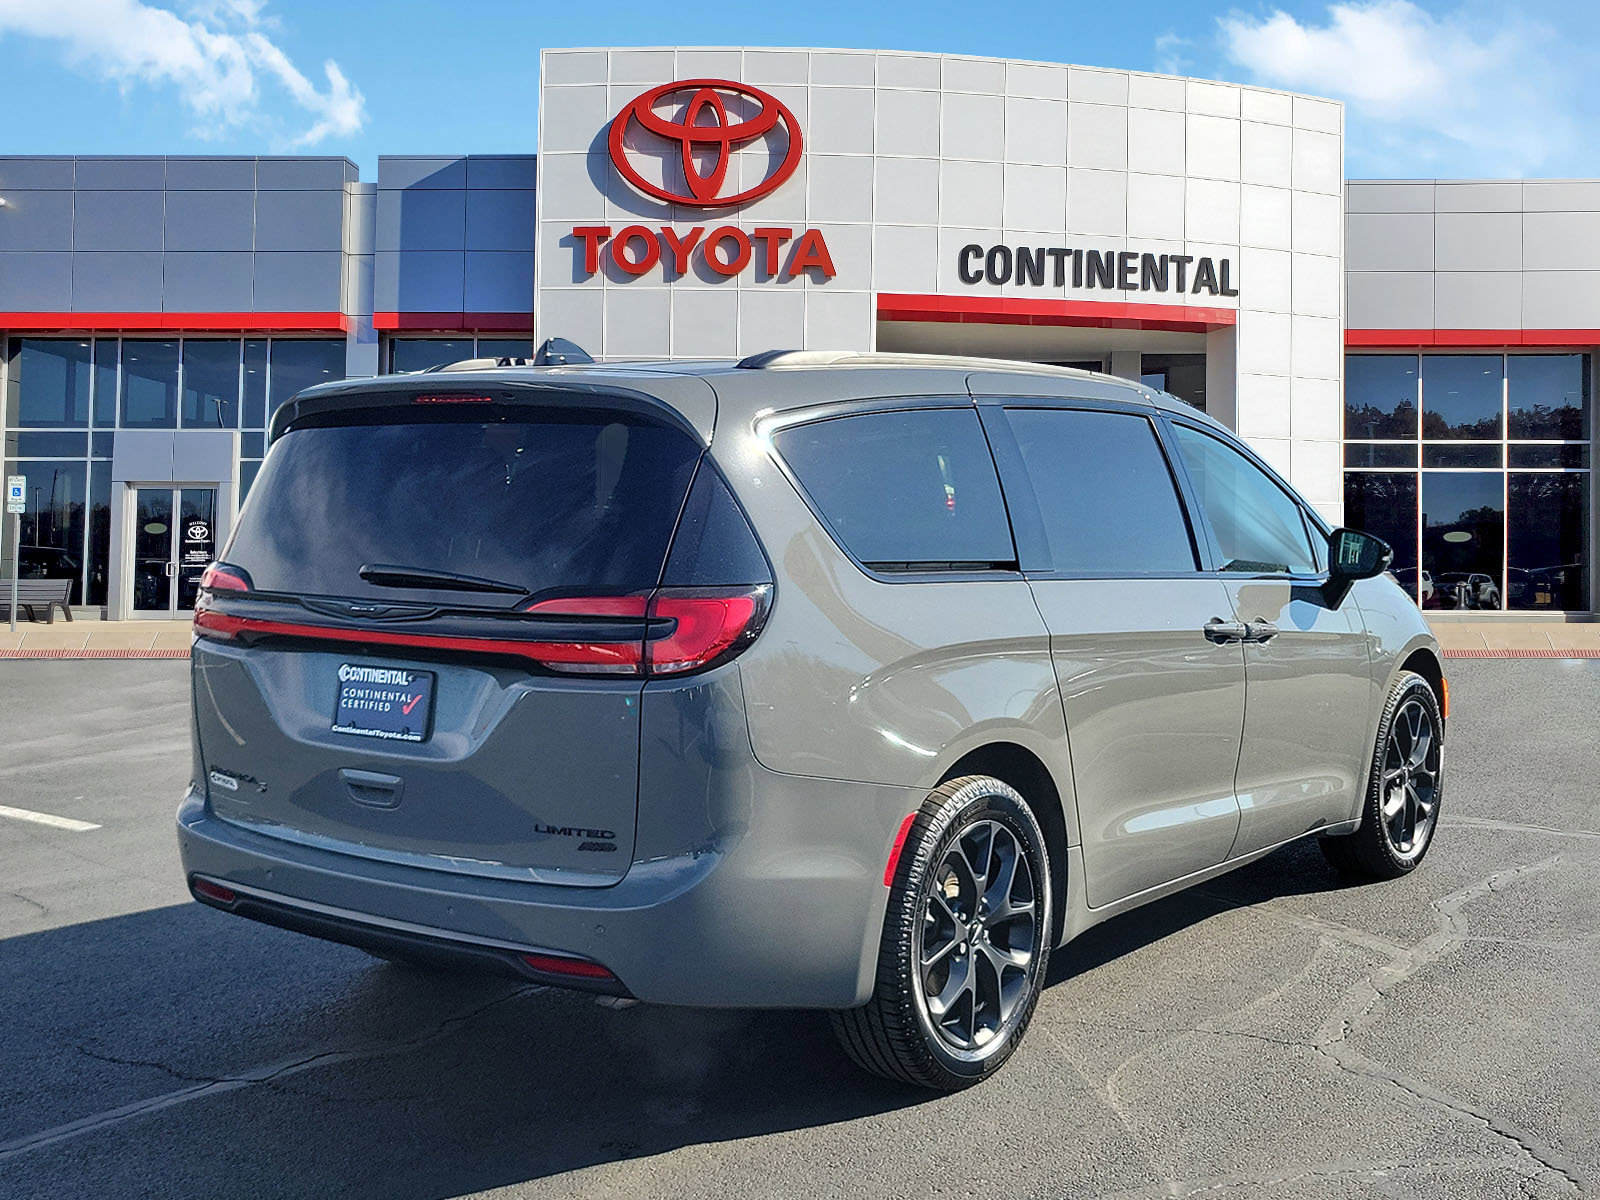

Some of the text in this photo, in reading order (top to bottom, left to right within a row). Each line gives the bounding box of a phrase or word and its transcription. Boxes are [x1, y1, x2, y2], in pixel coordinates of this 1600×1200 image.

[573, 225, 836, 276] TOYOTA
[958, 244, 1239, 296] CONTINENTAL
[338, 664, 409, 686] CONTINENTAL
[343, 688, 411, 703] CONTINENTAL
[341, 699, 391, 712] CERTIFIED
[331, 725, 421, 741] ContinentalToyota.com
[534, 824, 616, 839] LIMITED
